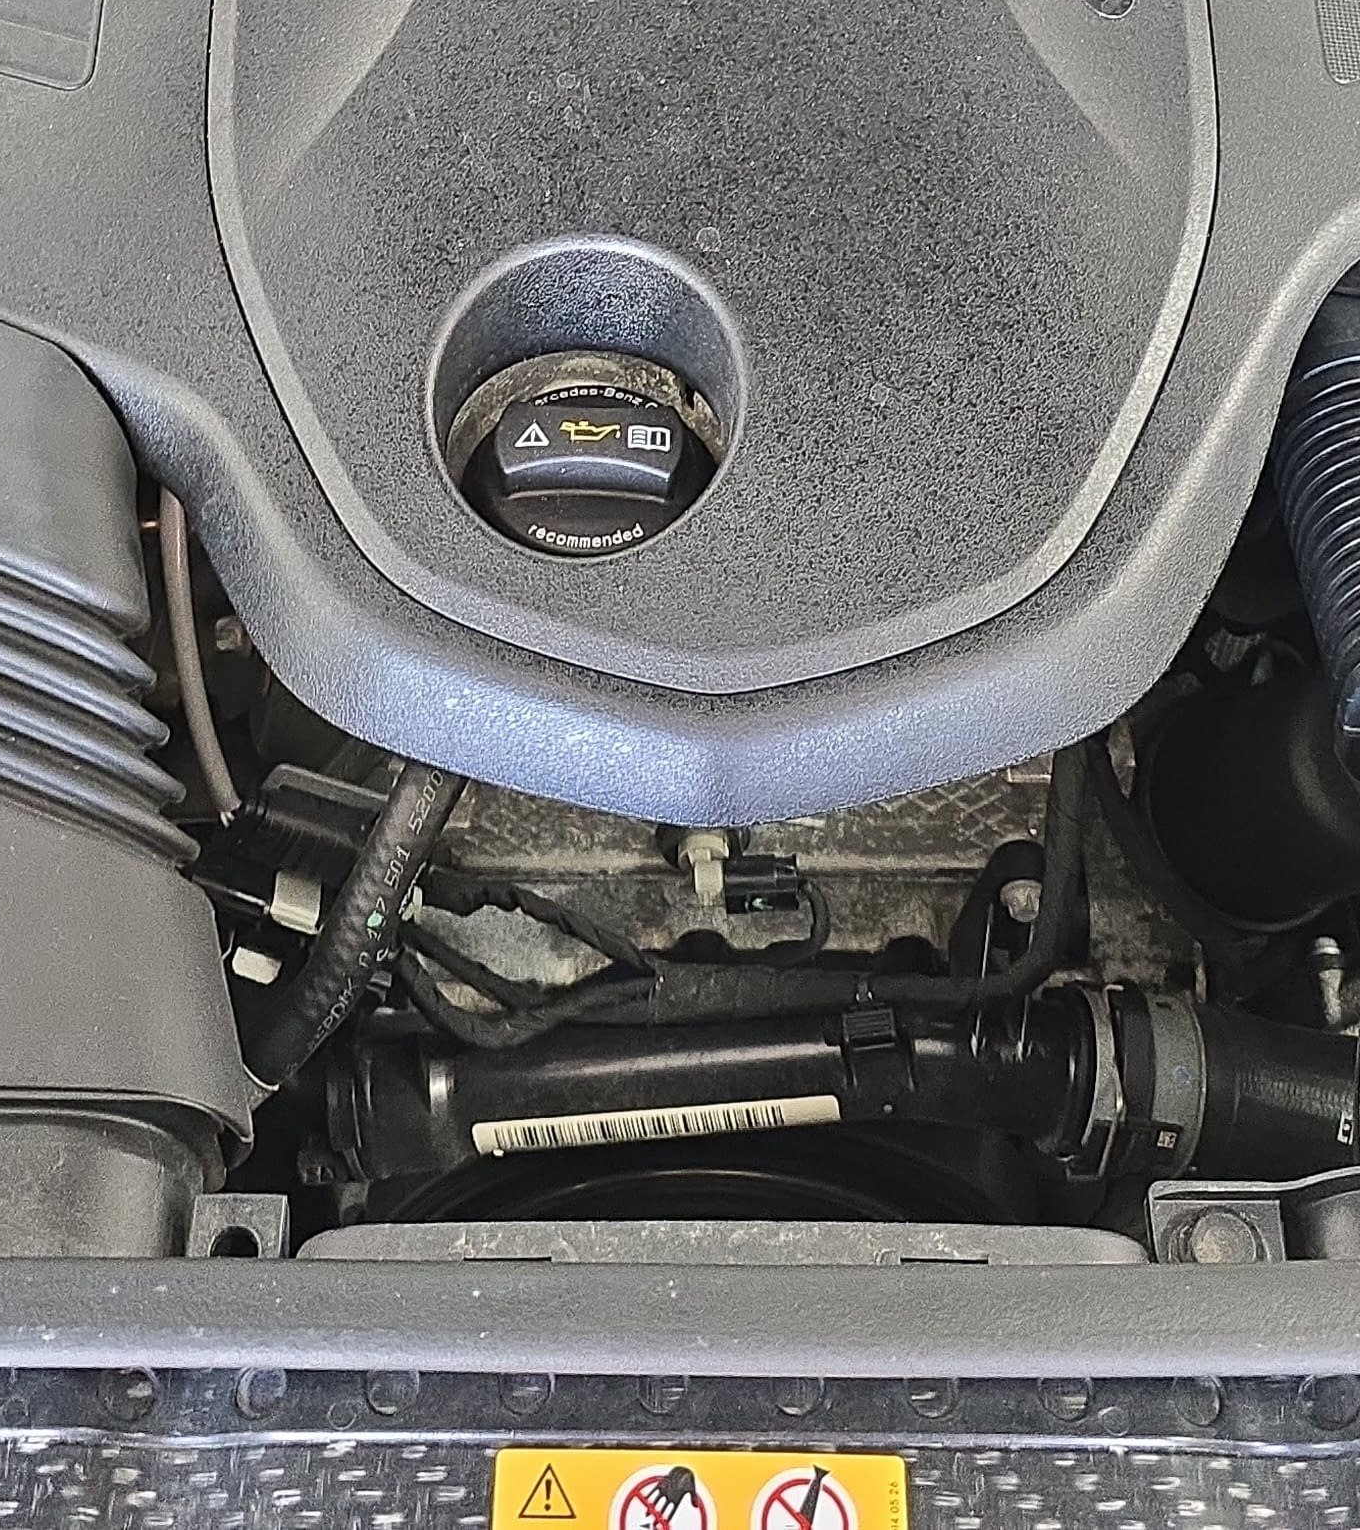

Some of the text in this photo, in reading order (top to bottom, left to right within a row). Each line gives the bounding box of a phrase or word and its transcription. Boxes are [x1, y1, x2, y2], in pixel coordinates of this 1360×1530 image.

[527, 522, 645, 550] recommended
[384, 845, 412, 891] 501
[407, 769, 445, 837] 5200
[888, 1481, 899, 1495] 26
